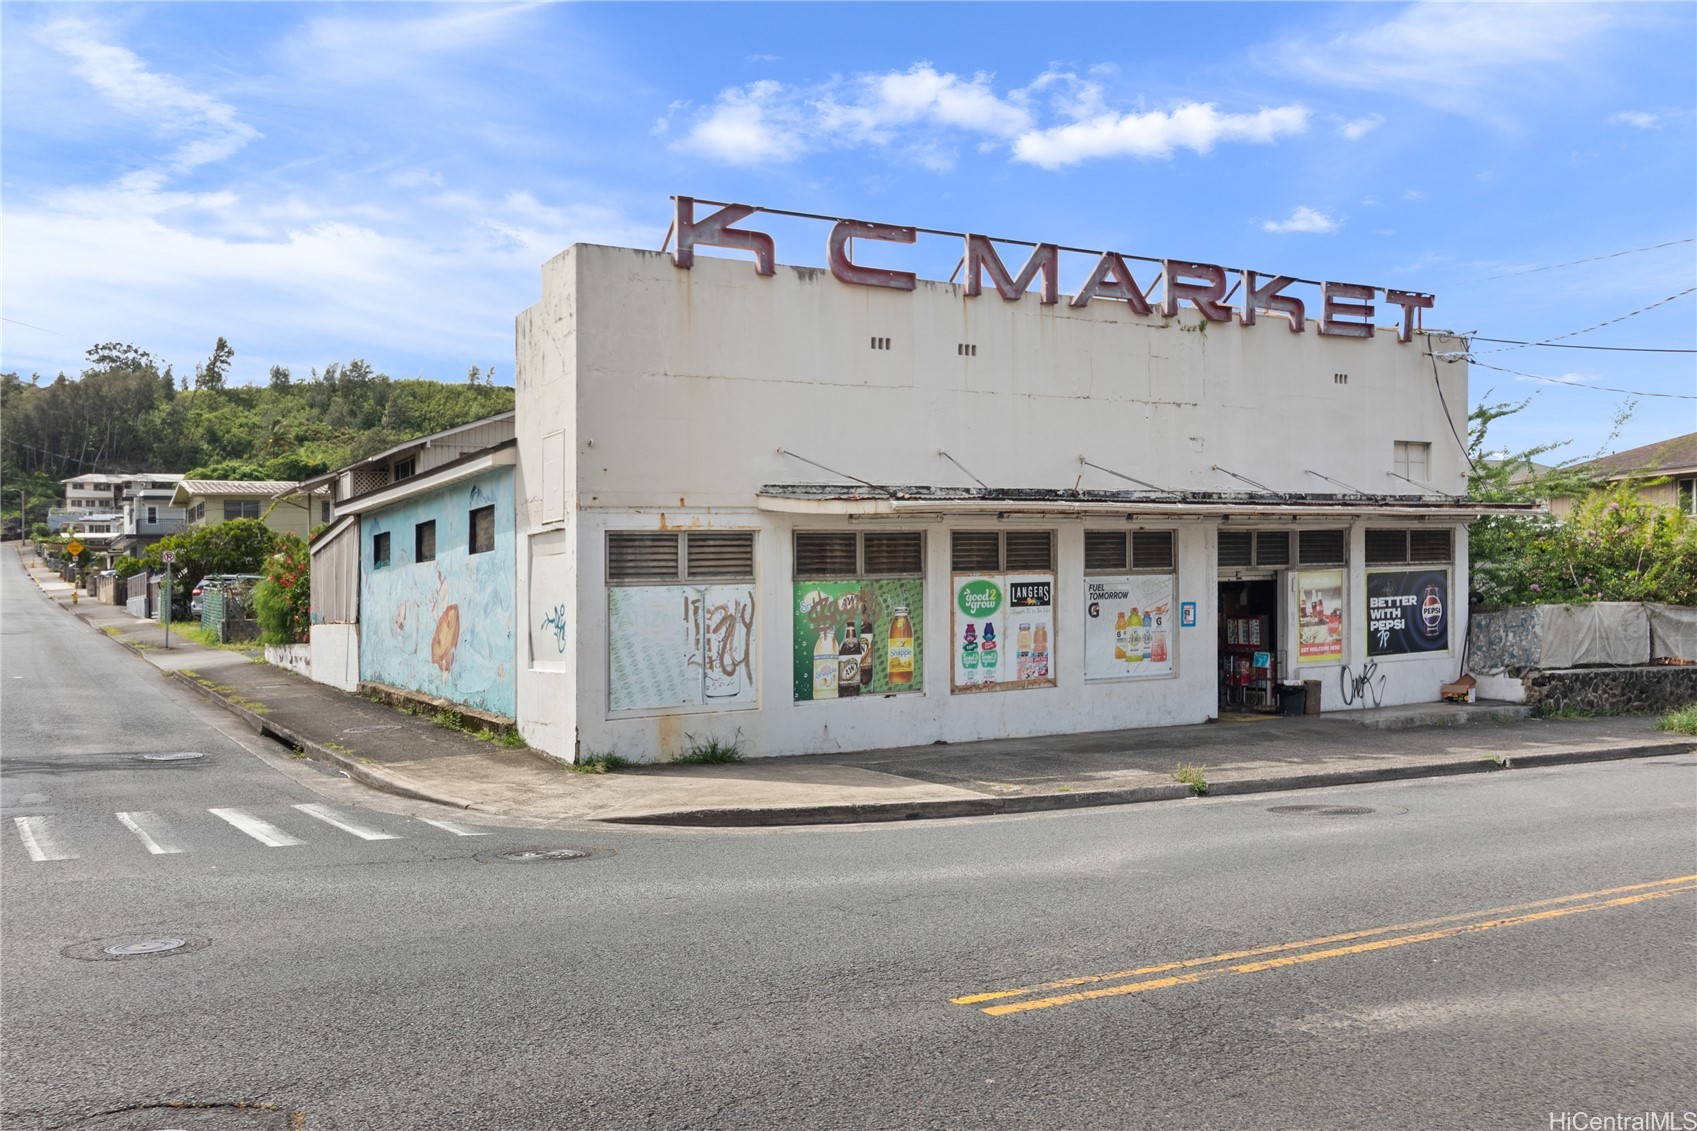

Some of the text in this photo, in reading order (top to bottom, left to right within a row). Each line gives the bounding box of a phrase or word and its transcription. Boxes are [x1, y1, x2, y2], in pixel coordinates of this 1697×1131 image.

[963, 232, 1435, 343] MARKET
[1012, 586, 1049, 602] LANGERS
[1089, 584, 1105, 592] FUEL
[1089, 592, 1129, 600] TOMORROW
[1370, 595, 1417, 608] BETTER
[970, 600, 996, 614] grow
[1088, 602, 1100, 618] G
[1370, 607, 1402, 620] WITH
[1423, 607, 1441, 615] PEPSI
[1370, 619, 1405, 631] PEPSI
